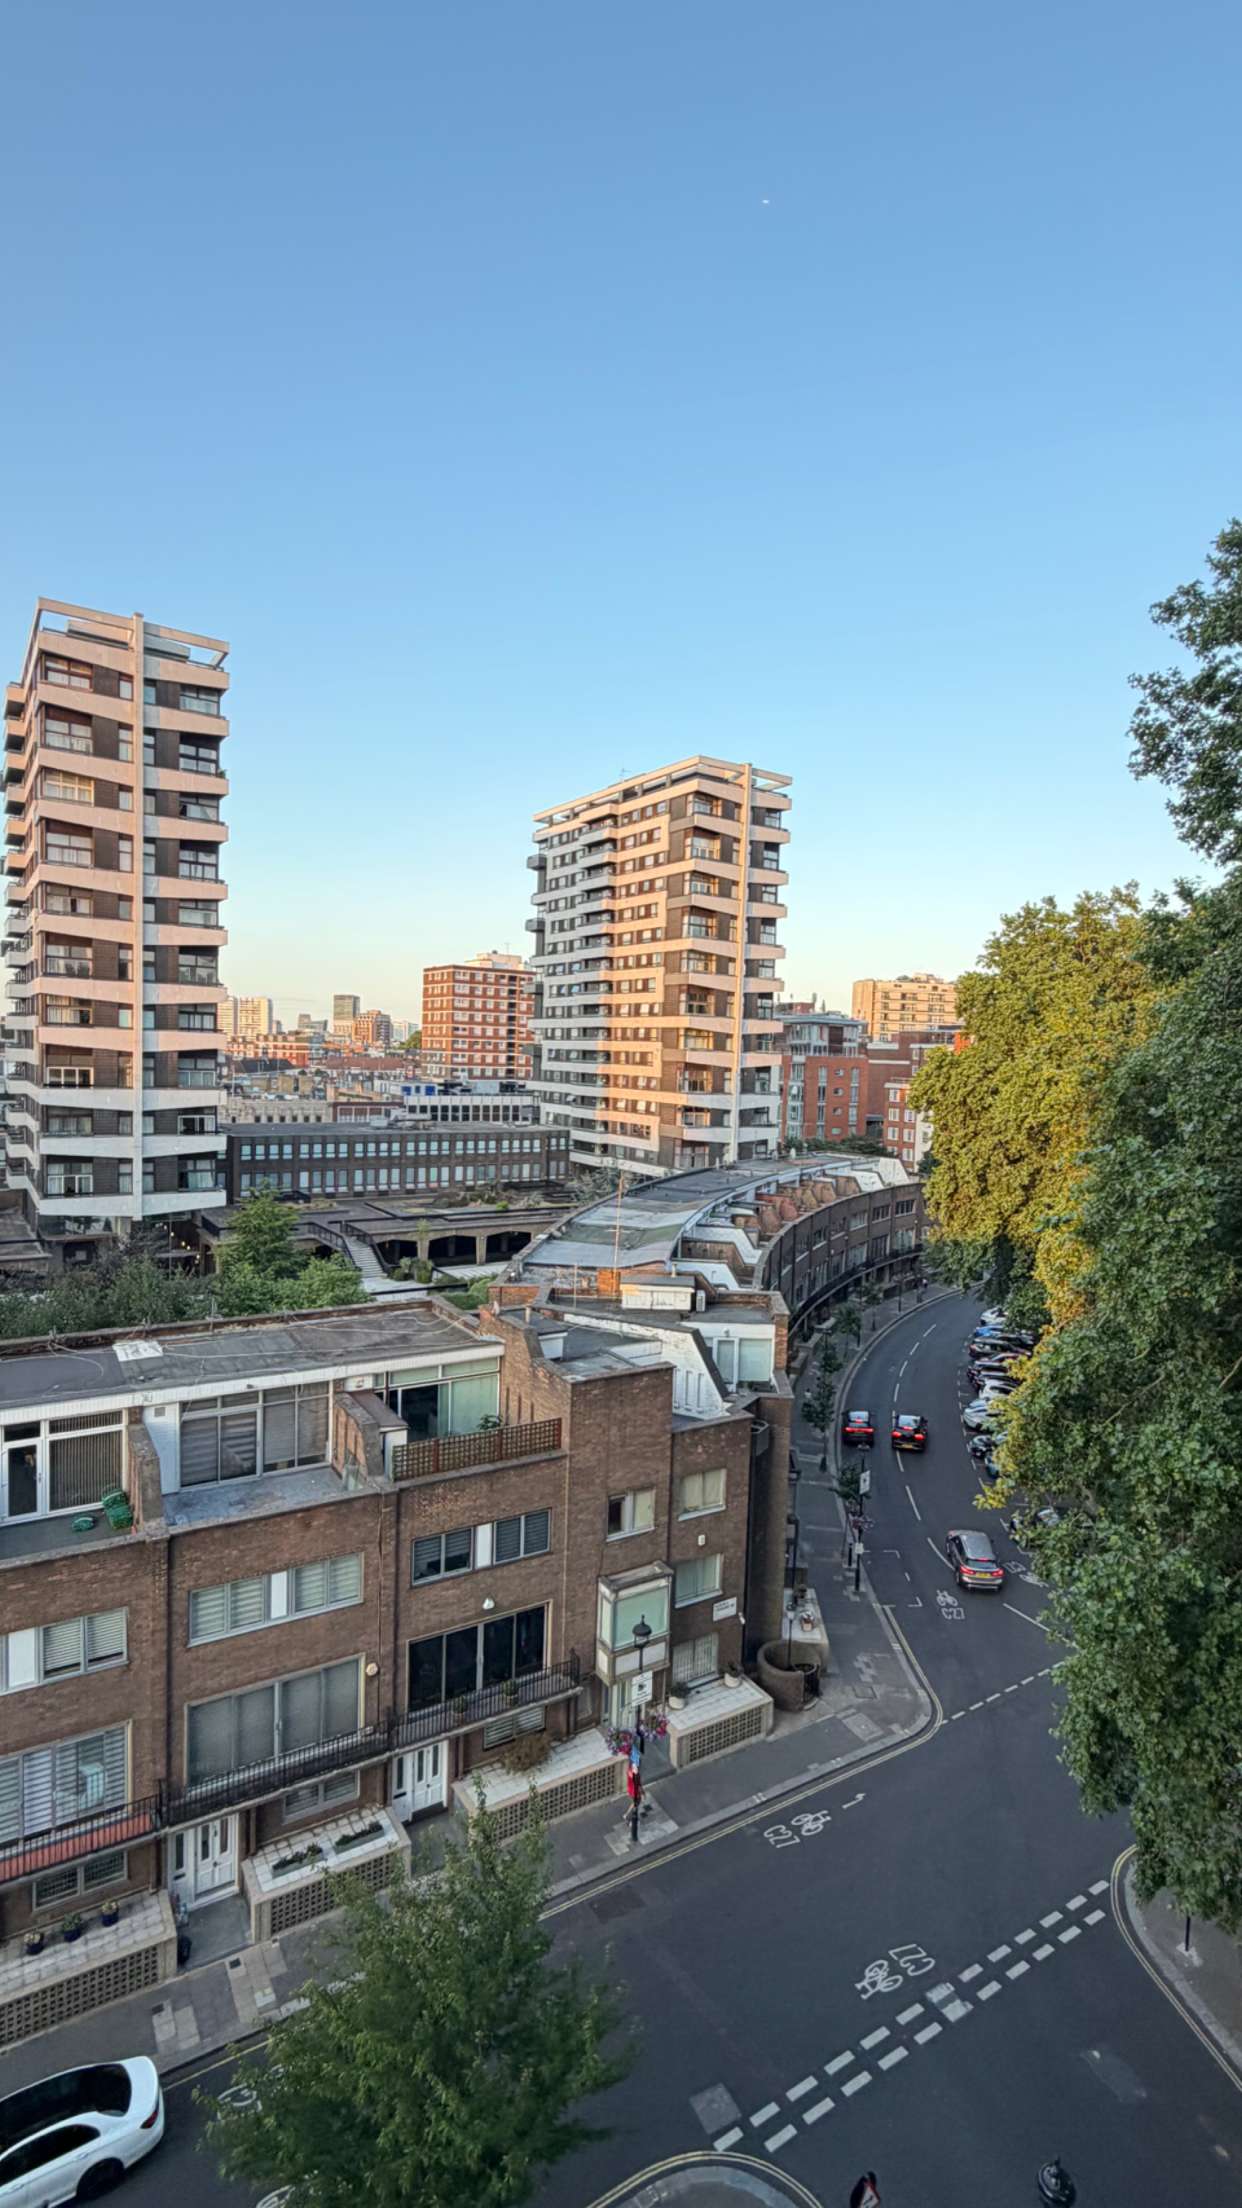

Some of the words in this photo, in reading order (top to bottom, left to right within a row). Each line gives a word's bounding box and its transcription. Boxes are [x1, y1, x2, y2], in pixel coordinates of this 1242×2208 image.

[941, 1607, 966, 1620] C27
[763, 1824, 800, 1848] C27
[888, 1943, 936, 1976] C27
